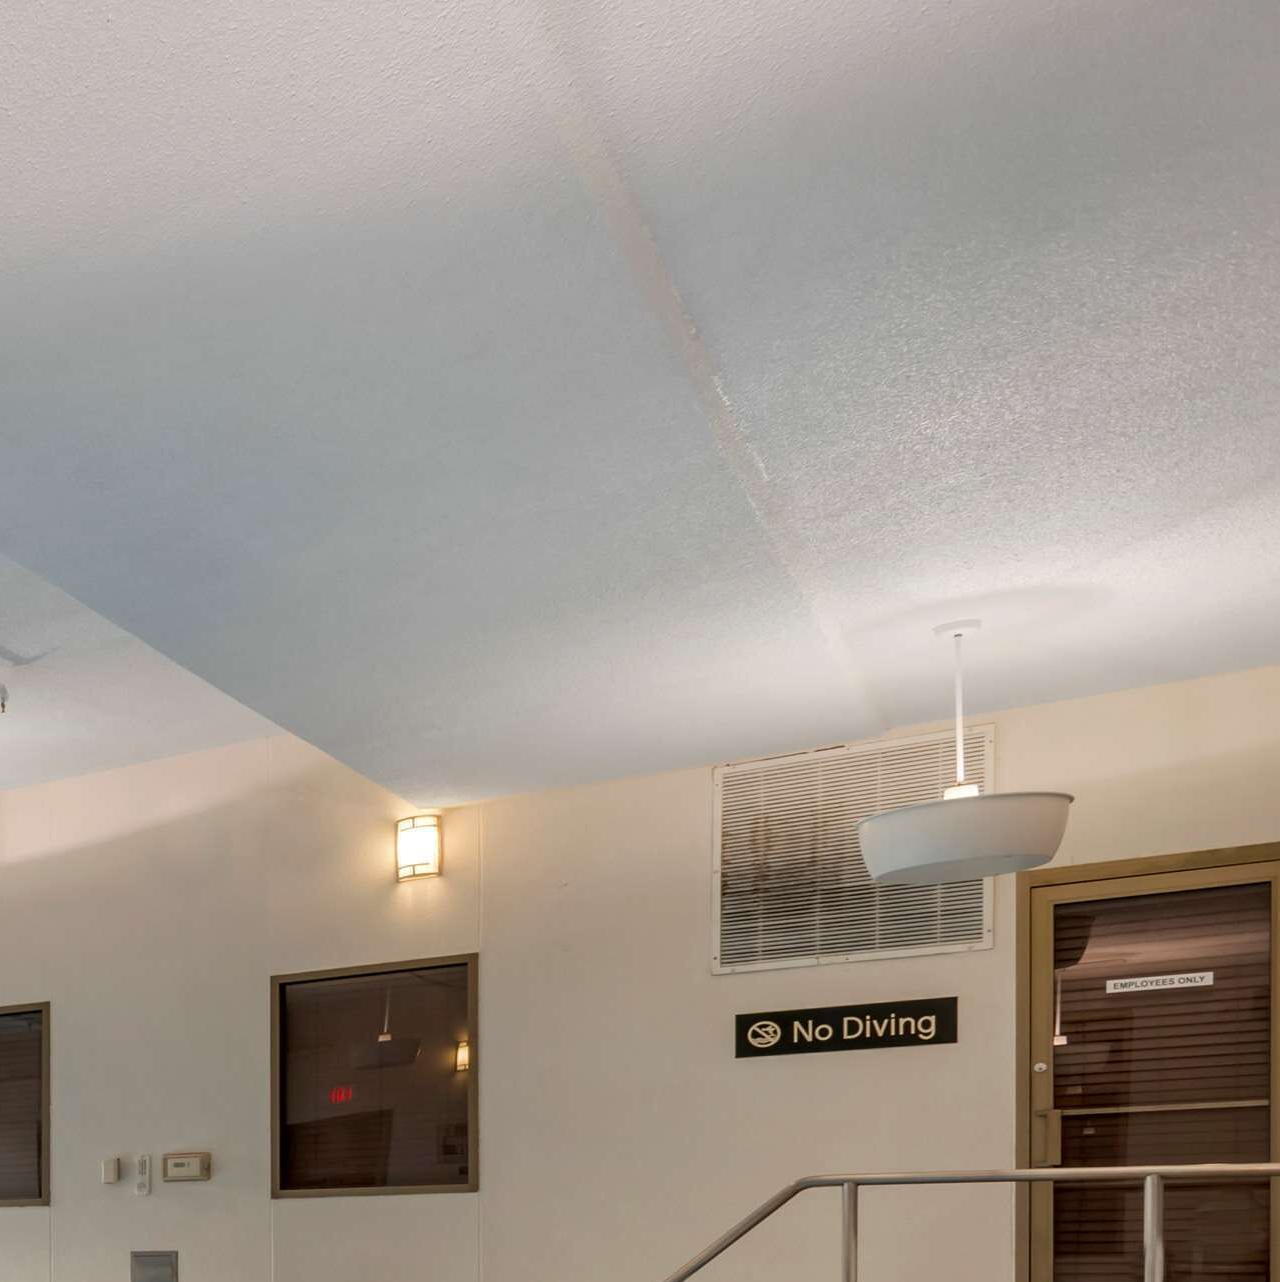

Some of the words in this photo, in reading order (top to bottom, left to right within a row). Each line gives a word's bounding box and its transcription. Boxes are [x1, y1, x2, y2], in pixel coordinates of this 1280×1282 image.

[1112, 977, 1176, 991] EMPLOYEES
[1177, 975, 1206, 986] ONLY
[792, 1019, 834, 1044] No
[842, 1012, 937, 1041] Diving
